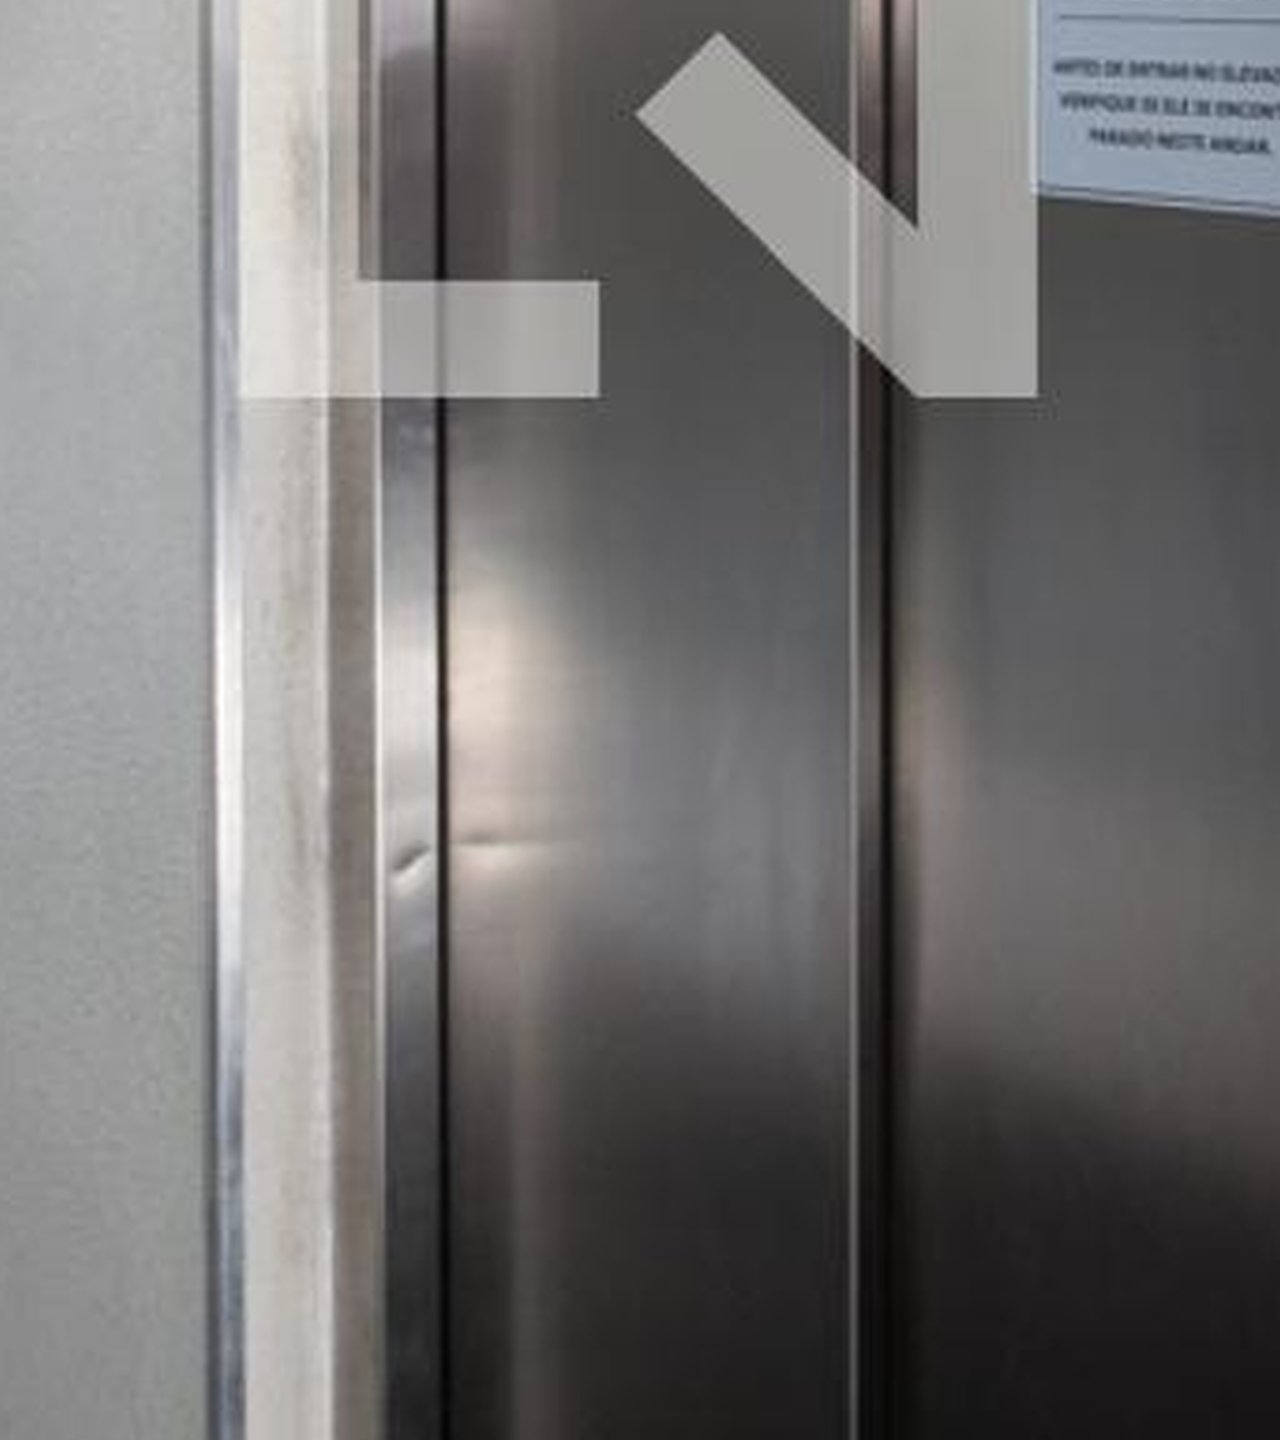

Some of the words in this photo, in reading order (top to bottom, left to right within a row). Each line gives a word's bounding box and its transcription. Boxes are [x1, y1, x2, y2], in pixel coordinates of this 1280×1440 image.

[1104, 60, 1124, 78] DE
[1128, 61, 1189, 80] ENTRAR
[1193, 63, 1216, 81] NO
[1059, 93, 1137, 114] VERIFIQUE
[1140, 95, 1158, 115] SE
[1088, 128, 1153, 149] PARADO
[1157, 132, 1207, 151] NESTE
